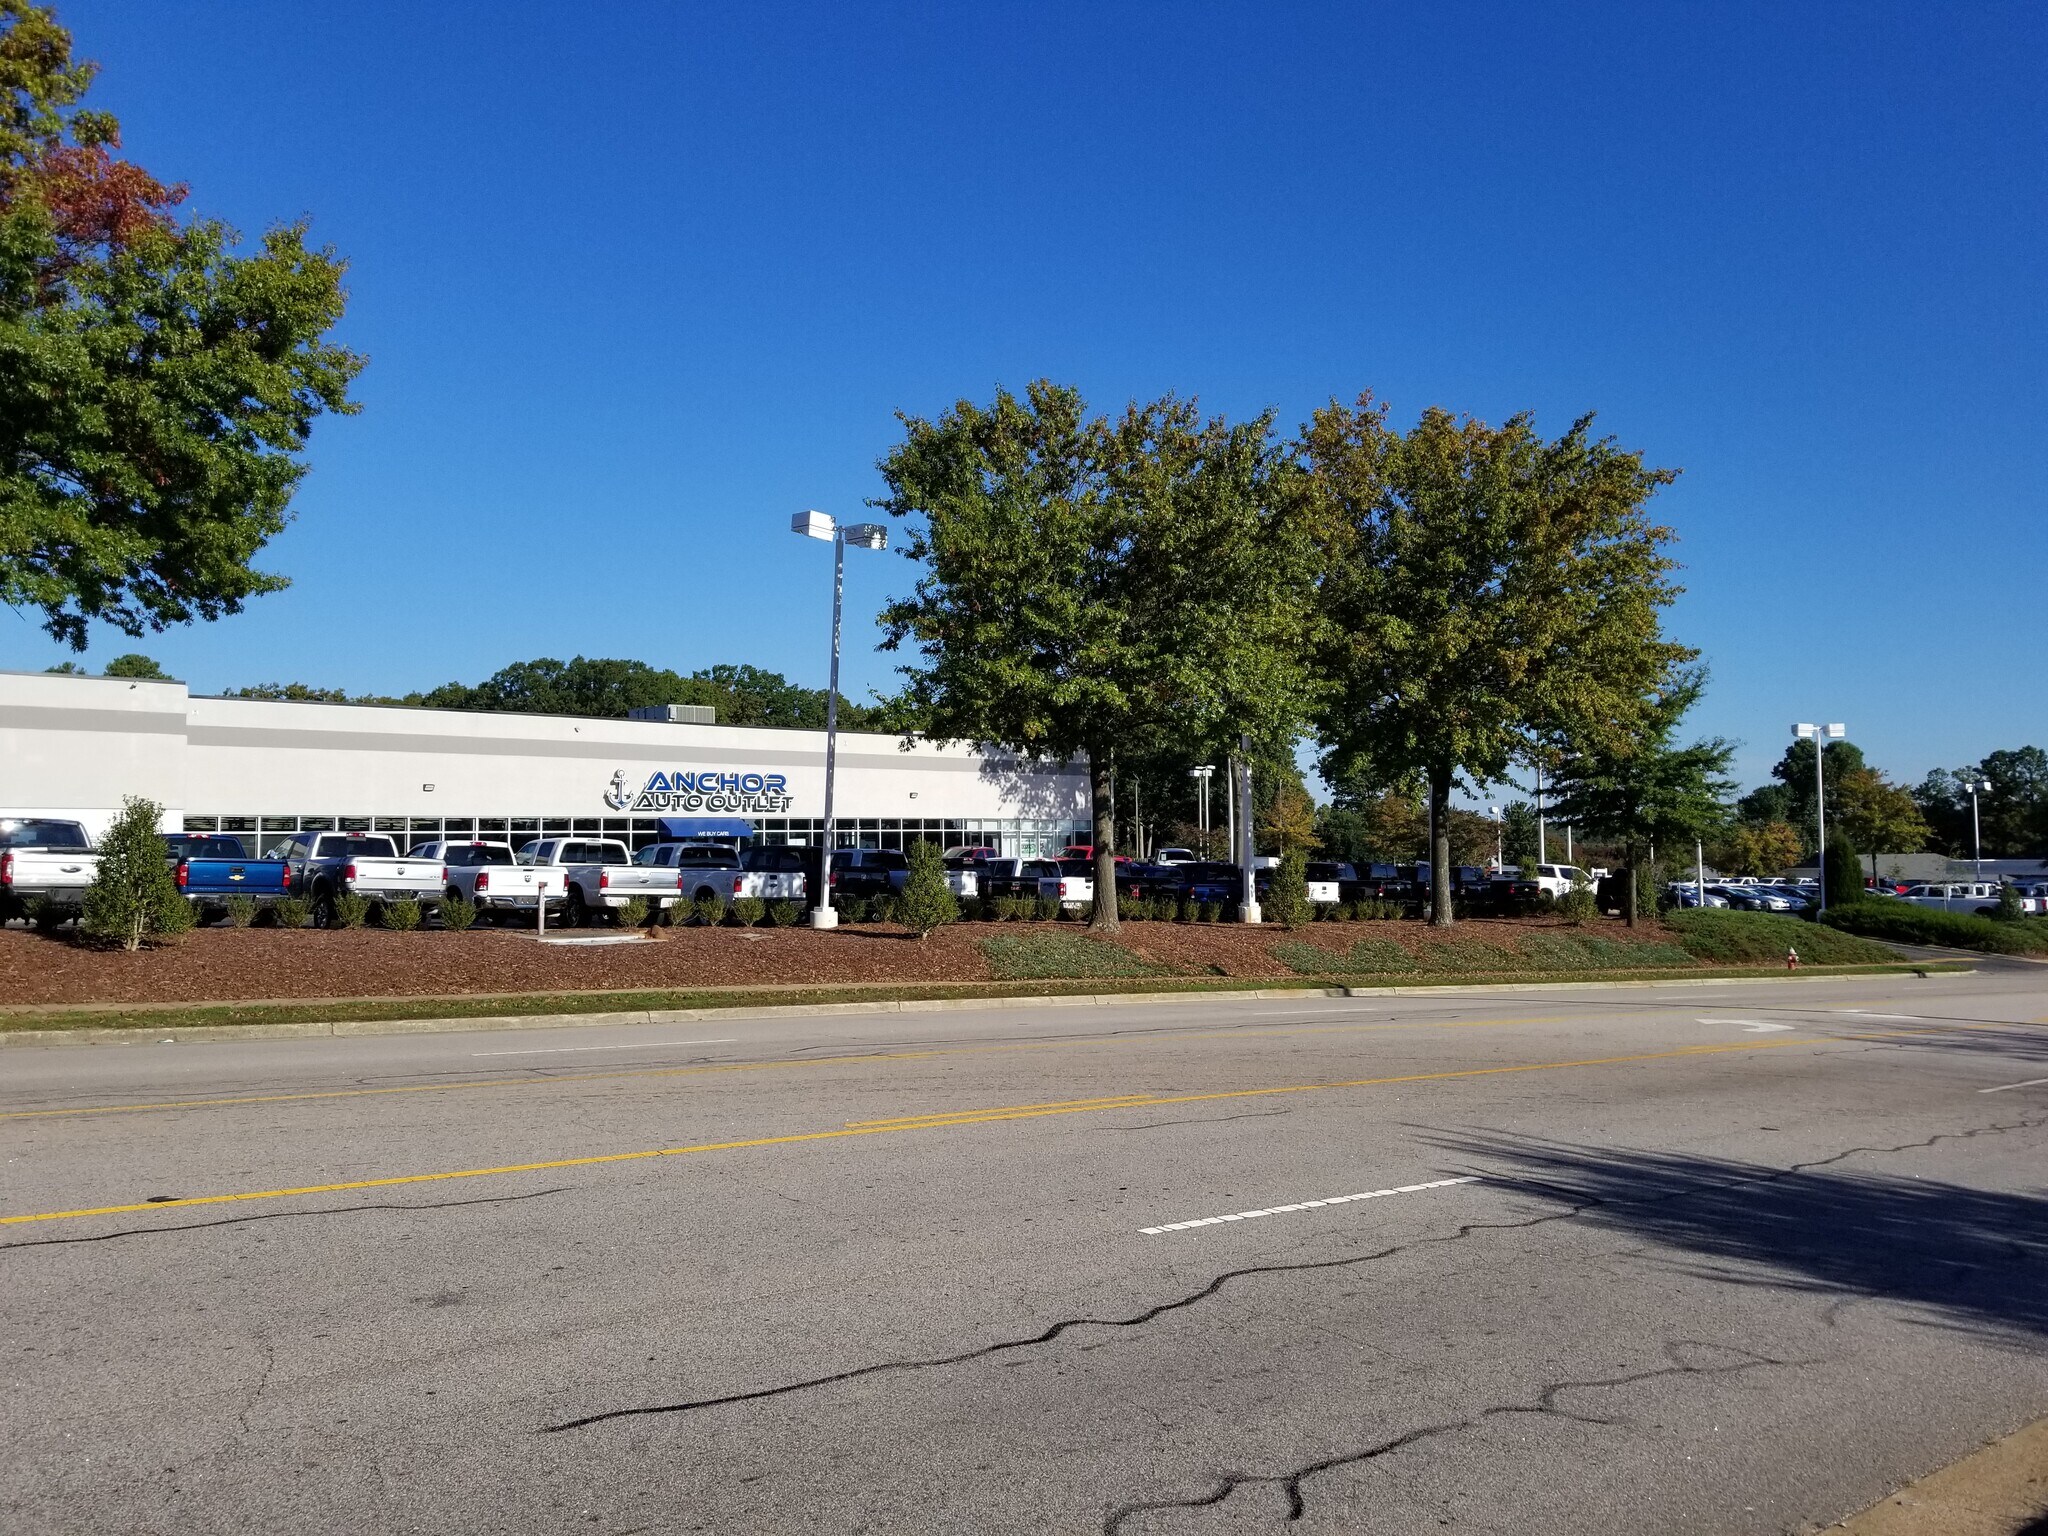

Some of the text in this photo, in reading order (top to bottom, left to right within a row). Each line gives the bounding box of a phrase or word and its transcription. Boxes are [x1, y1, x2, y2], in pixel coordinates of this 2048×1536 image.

[645, 770, 788, 793] ANCHOR
[634, 793, 794, 811] AUTO OUTLET
